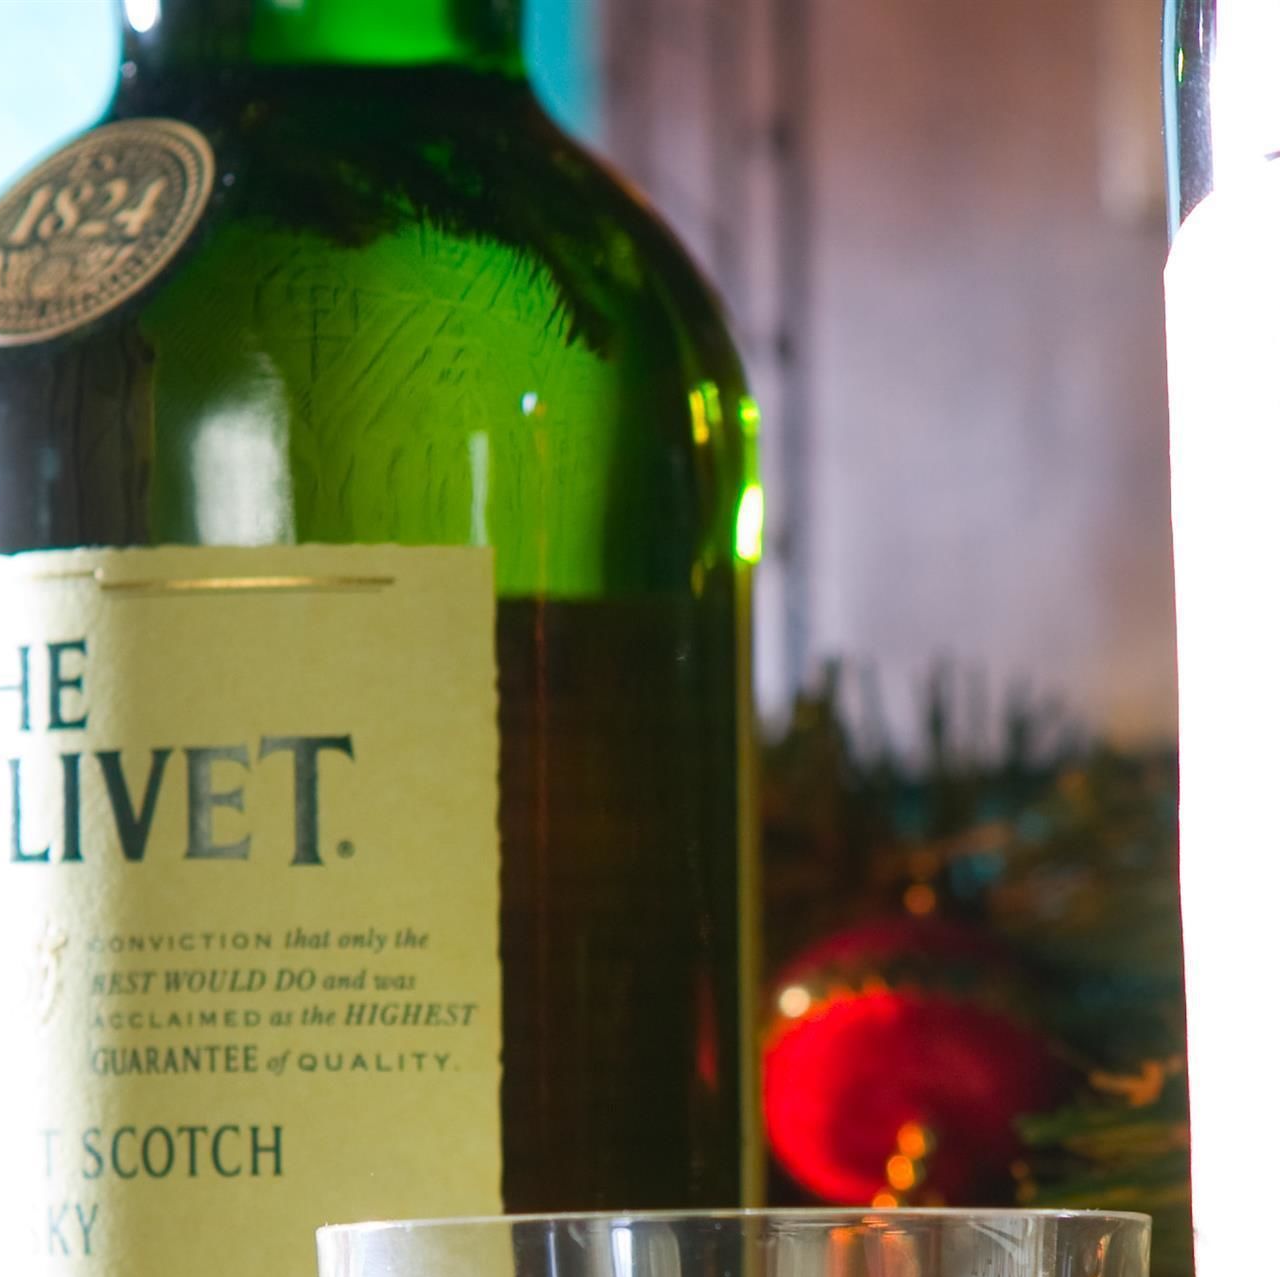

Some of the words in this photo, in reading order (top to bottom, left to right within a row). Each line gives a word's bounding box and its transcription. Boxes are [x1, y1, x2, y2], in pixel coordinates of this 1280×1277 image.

[89, 933, 273, 953] CONVICTION
[284, 928, 331, 950] that
[338, 928, 387, 955] only
[395, 928, 430, 950] the
[165, 968, 266, 994] WOULD
[275, 968, 317, 993] DO
[322, 969, 367, 992] and
[373, 973, 417, 992] was
[91, 1009, 262, 1030] ACCLAIMED
[269, 1010, 294, 1029] as
[300, 1004, 337, 1027] the
[344, 1003, 479, 1027] HIGHEST
[91, 1046, 259, 1077] GUARANTEE
[266, 1048, 290, 1074] of
[81, 1125, 284, 1180] SCOTCH
